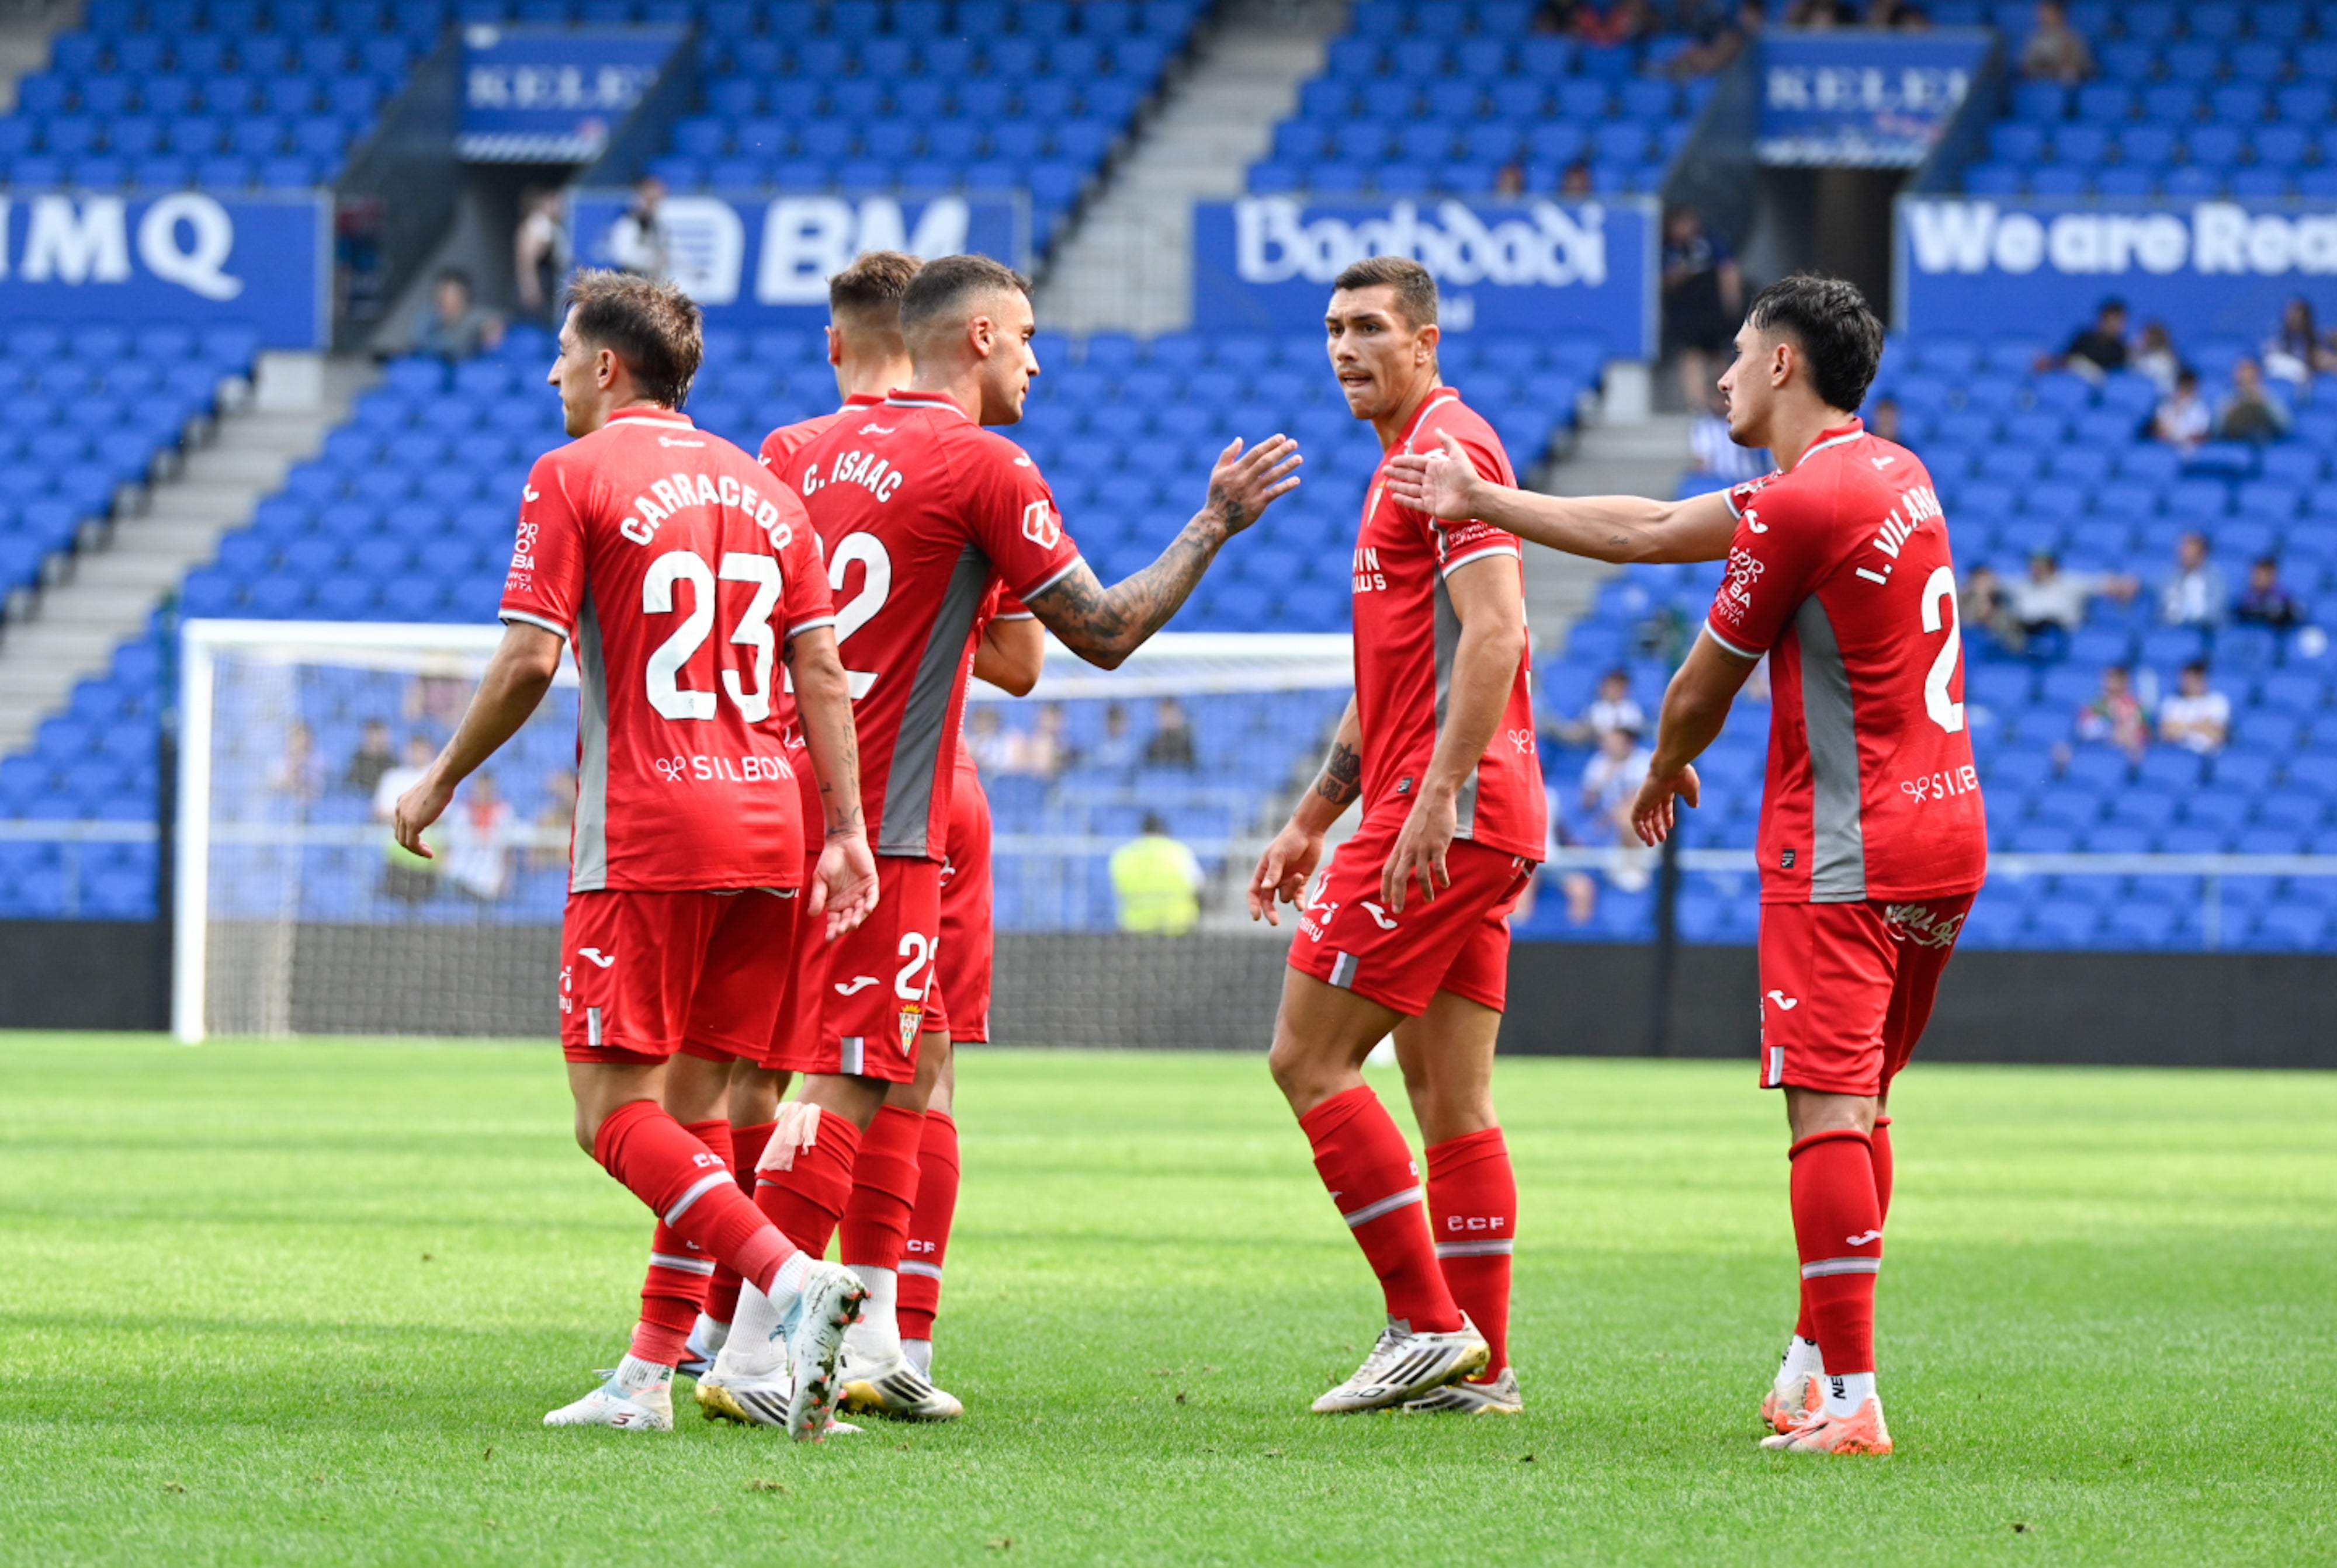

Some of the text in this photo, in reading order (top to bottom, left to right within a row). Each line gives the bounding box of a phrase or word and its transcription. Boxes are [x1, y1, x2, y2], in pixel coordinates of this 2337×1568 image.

[469, 64, 659, 110] KELE
[1906, 200, 2045, 275] We
[2048, 211, 2190, 275] are
[802, 450, 903, 503] C. ISAAC
[620, 473, 793, 550] CARRACEDO
[643, 550, 783, 724] 23
[693, 755, 794, 782] SILBON
[907, 1239, 935, 1254] CF
